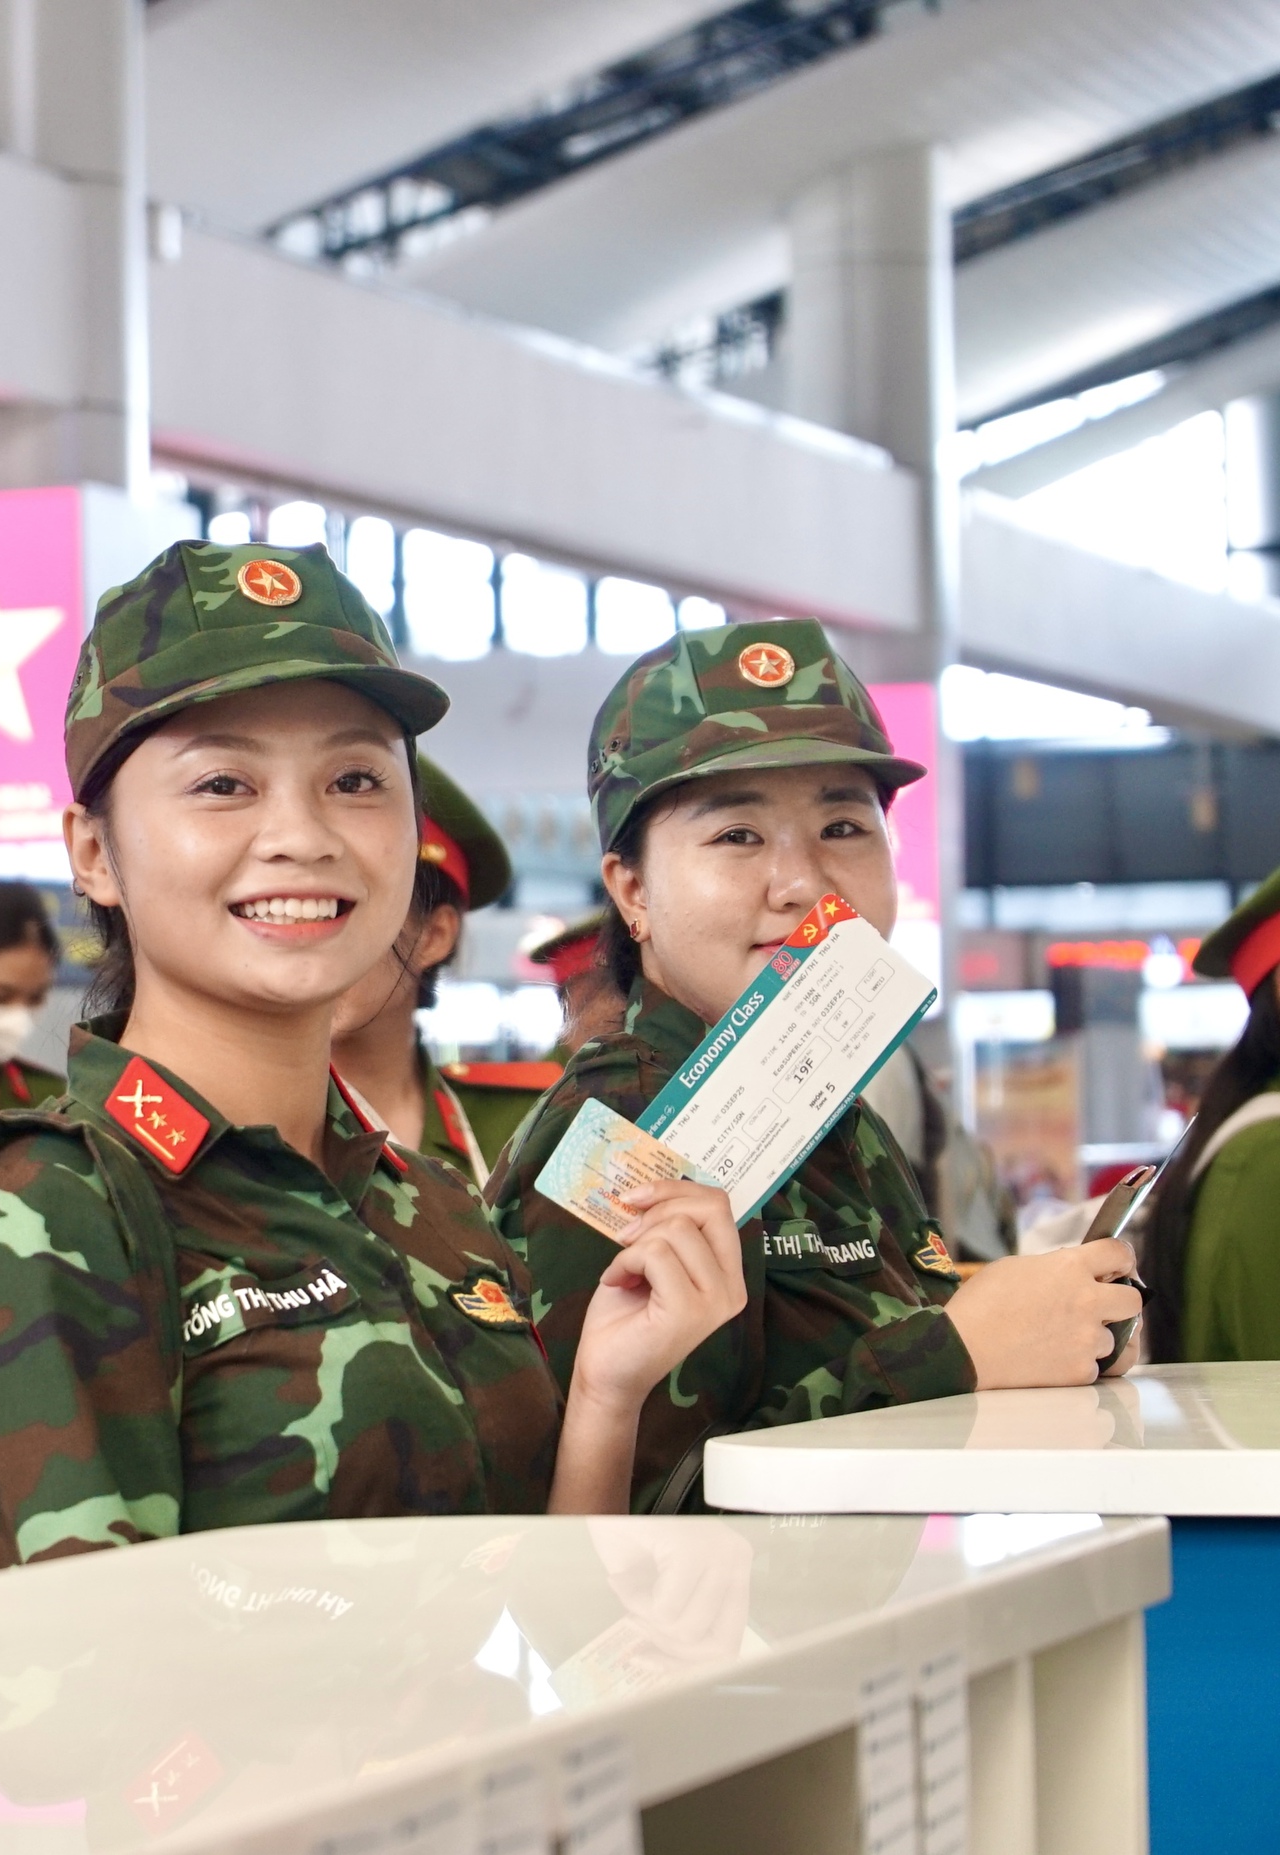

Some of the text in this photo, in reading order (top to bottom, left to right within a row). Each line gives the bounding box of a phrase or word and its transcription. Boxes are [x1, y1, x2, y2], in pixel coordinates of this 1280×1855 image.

[768, 948, 795, 975] 80
[678, 987, 766, 1091] Economy Class
[777, 1021, 797, 1043] 14:00
[792, 1057, 816, 1083] 19F
[719, 1084, 745, 1114] 03SEP25
[824, 1081, 837, 1093] 5
[773, 1235, 803, 1259] THỊ
[825, 1238, 876, 1264] TRANG
[182, 1293, 236, 1342] TỐNG
[266, 1288, 311, 1310] THU
[307, 1268, 347, 1302] HÀ
